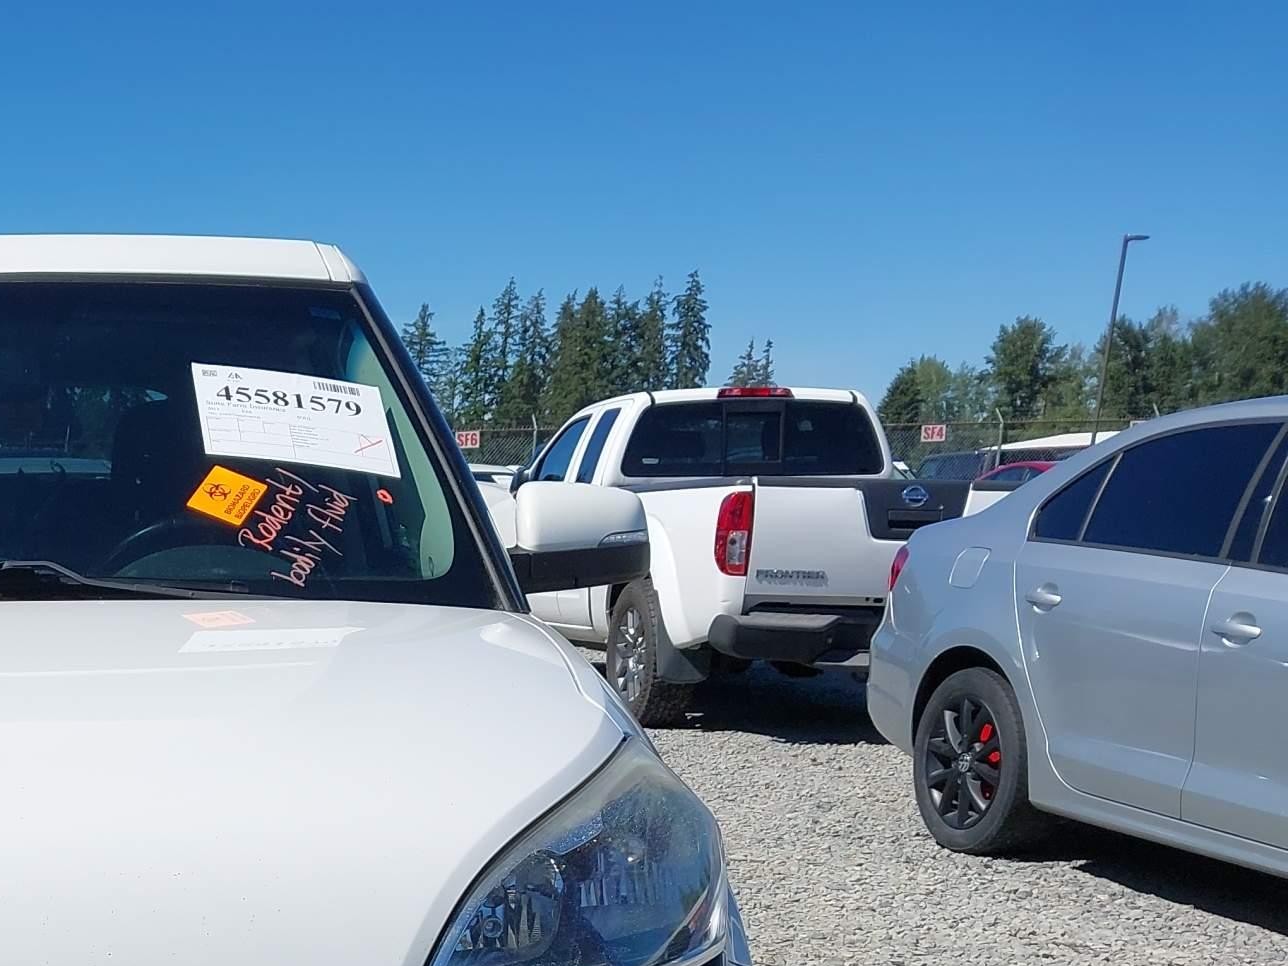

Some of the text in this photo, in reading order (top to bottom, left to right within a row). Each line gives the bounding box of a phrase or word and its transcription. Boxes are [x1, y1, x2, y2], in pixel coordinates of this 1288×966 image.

[216, 385, 362, 417] 45581579
[457, 432, 478, 447] SF6
[923, 426, 944, 440] SF4
[224, 484, 250, 515] BIOHAZARD
[755, 569, 826, 580] FRONTIER
